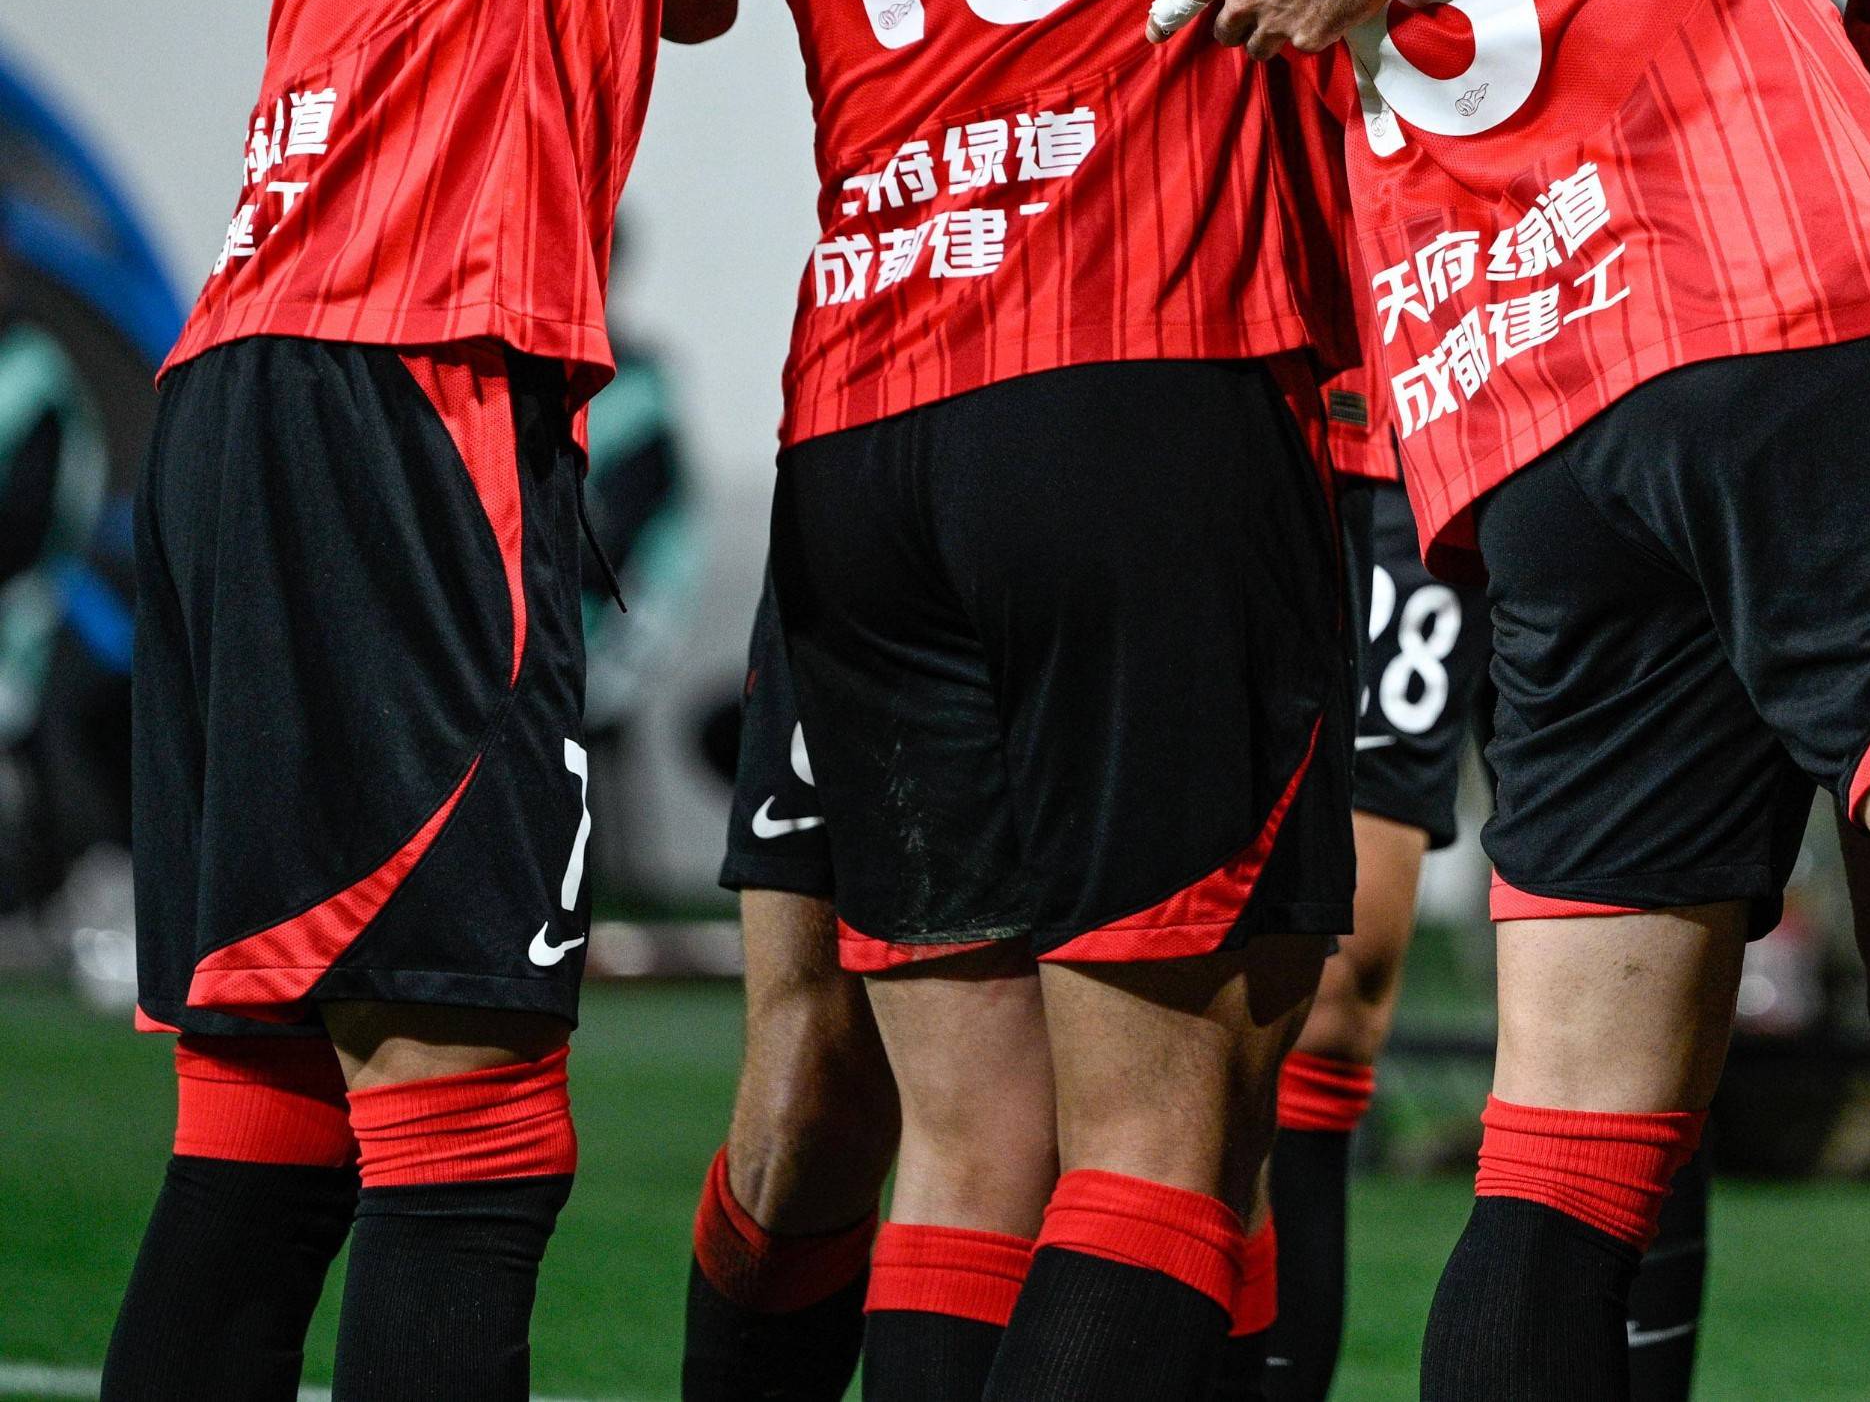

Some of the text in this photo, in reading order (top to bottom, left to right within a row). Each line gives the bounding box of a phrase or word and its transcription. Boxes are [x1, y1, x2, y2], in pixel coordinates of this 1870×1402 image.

[814, 201, 1049, 308] 成都建
[1371, 160, 1611, 346] 天府绿道
[1391, 243, 1631, 440] 成都建工
